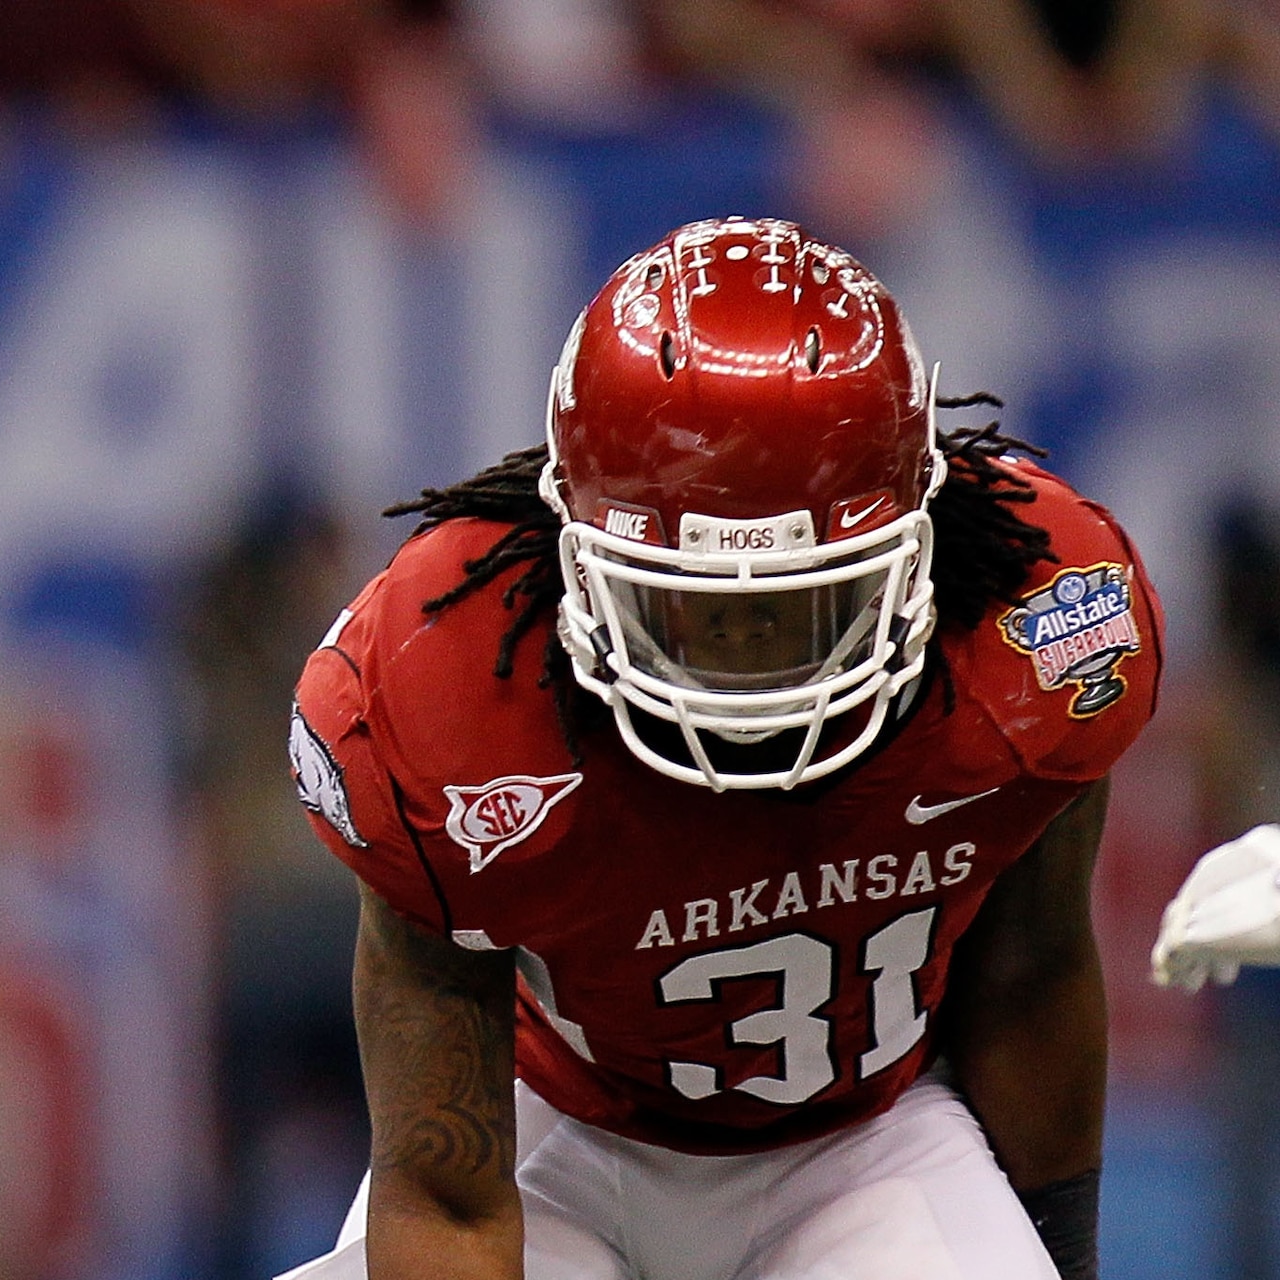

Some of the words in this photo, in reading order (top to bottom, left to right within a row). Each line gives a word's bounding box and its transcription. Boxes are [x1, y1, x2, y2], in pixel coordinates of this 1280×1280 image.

[605, 508, 648, 540] NIKE
[720, 527, 775, 550] HOGS
[1034, 591, 1121, 645] Allstate
[476, 791, 526, 836] SEC
[636, 842, 977, 950] ARKANSAS
[655, 908, 937, 1106] 31
